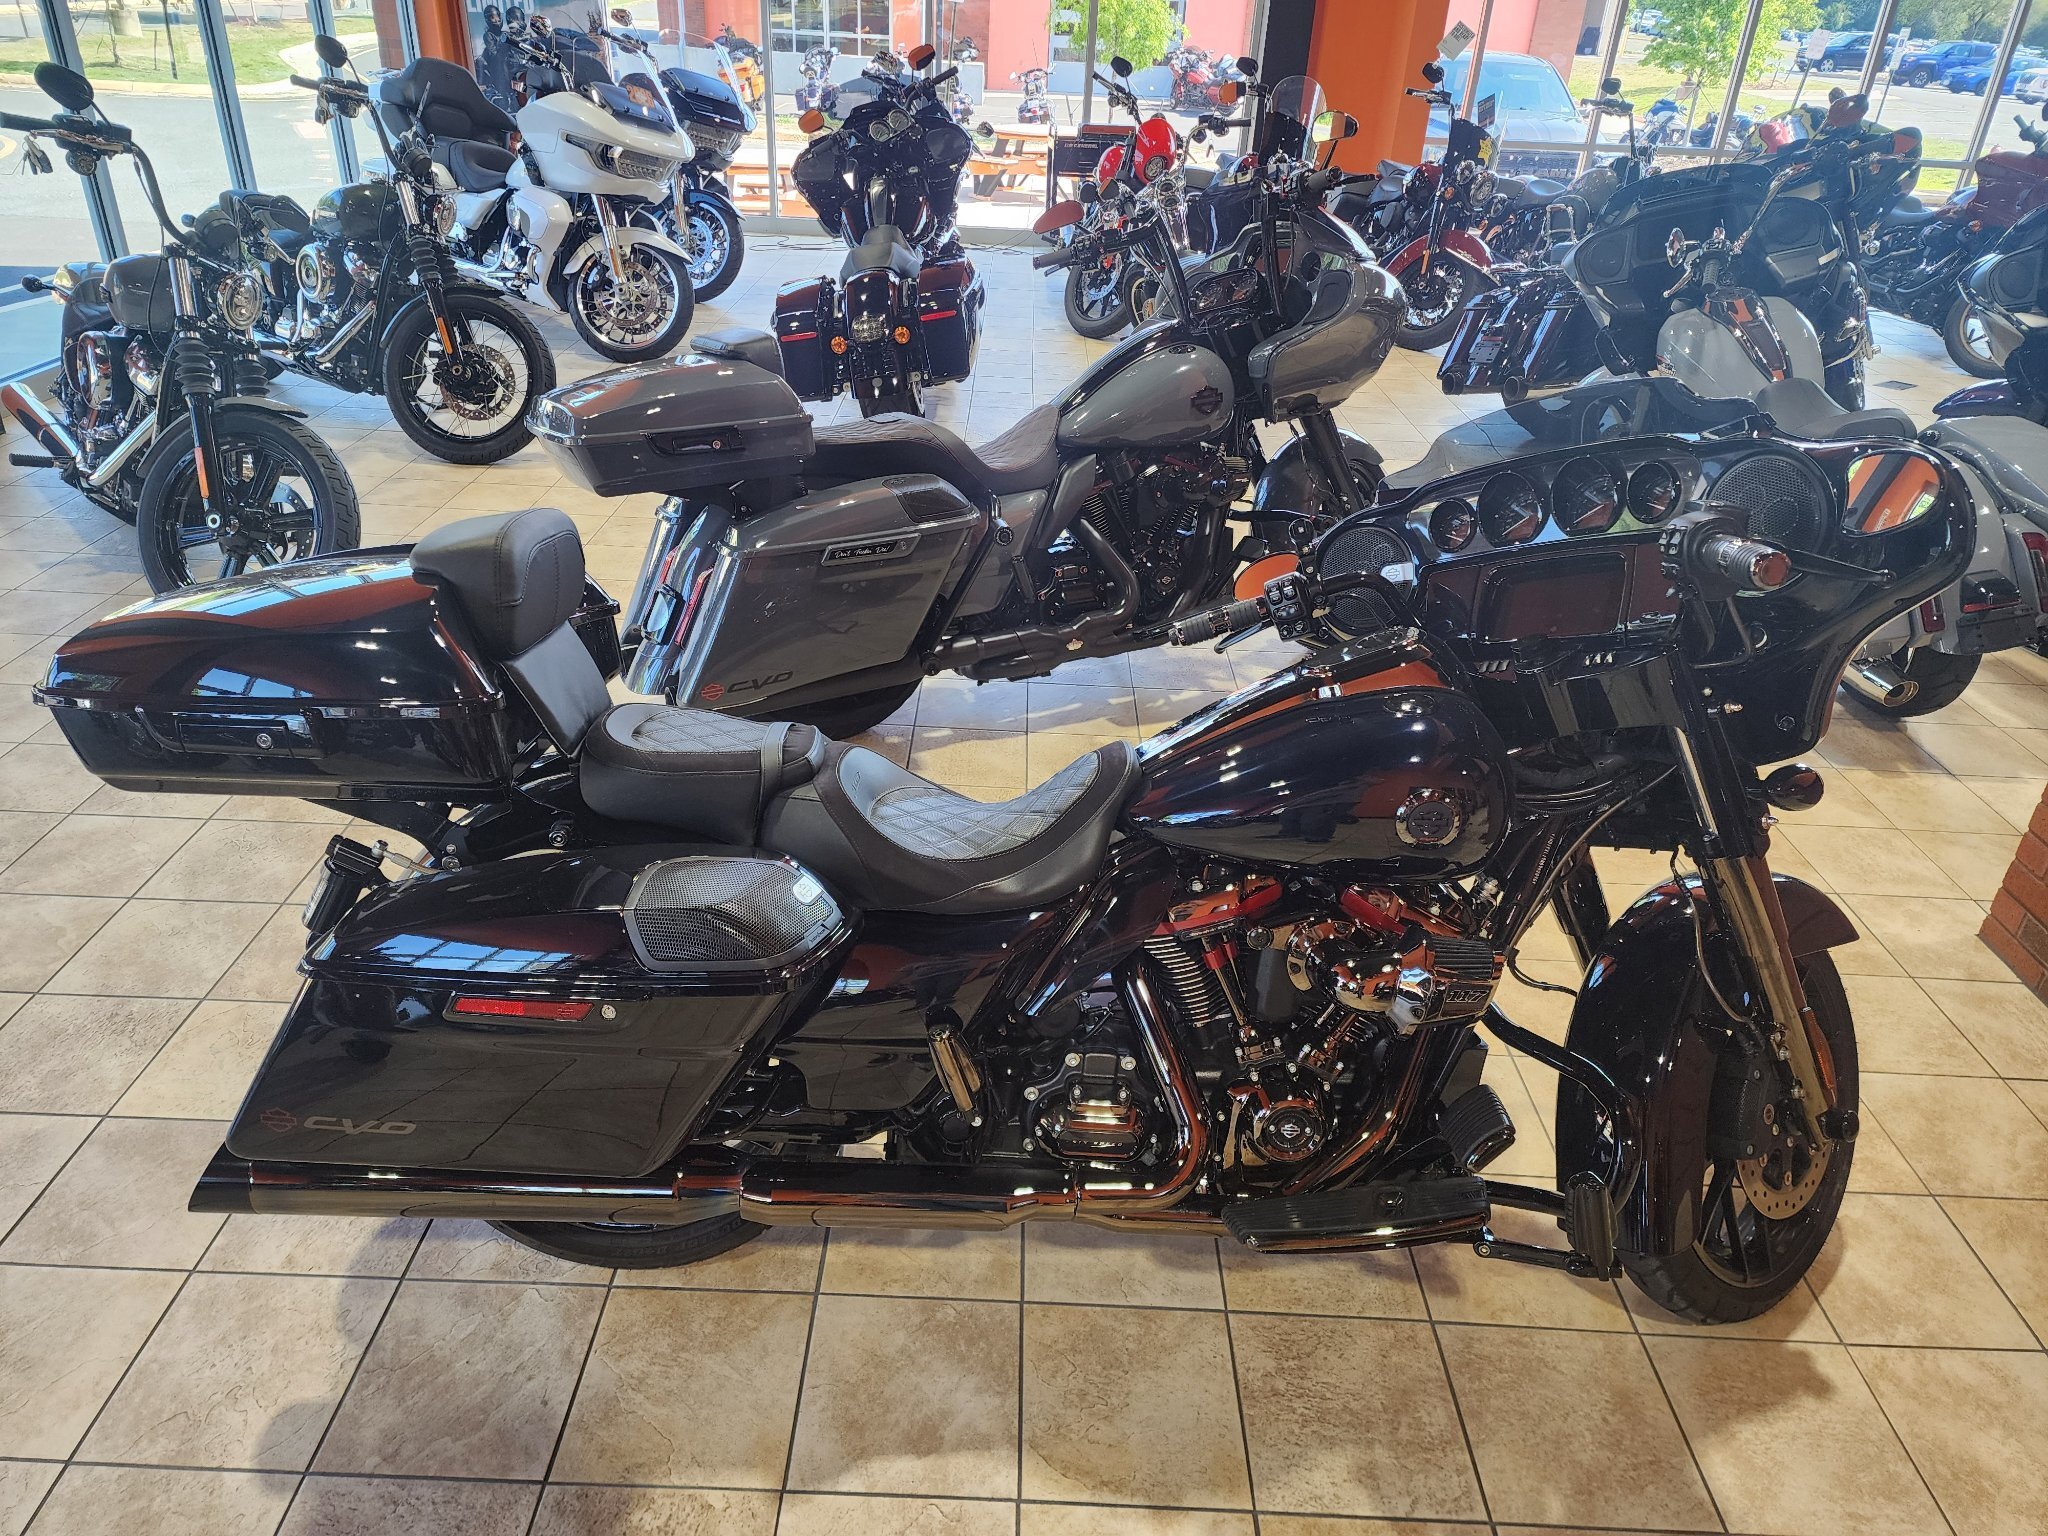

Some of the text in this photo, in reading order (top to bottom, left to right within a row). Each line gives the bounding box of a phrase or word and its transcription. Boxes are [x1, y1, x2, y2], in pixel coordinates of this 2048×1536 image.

[727, 670, 794, 694] CVO
[1446, 989, 1490, 1003] 117
[303, 1115, 417, 1136] CVO
